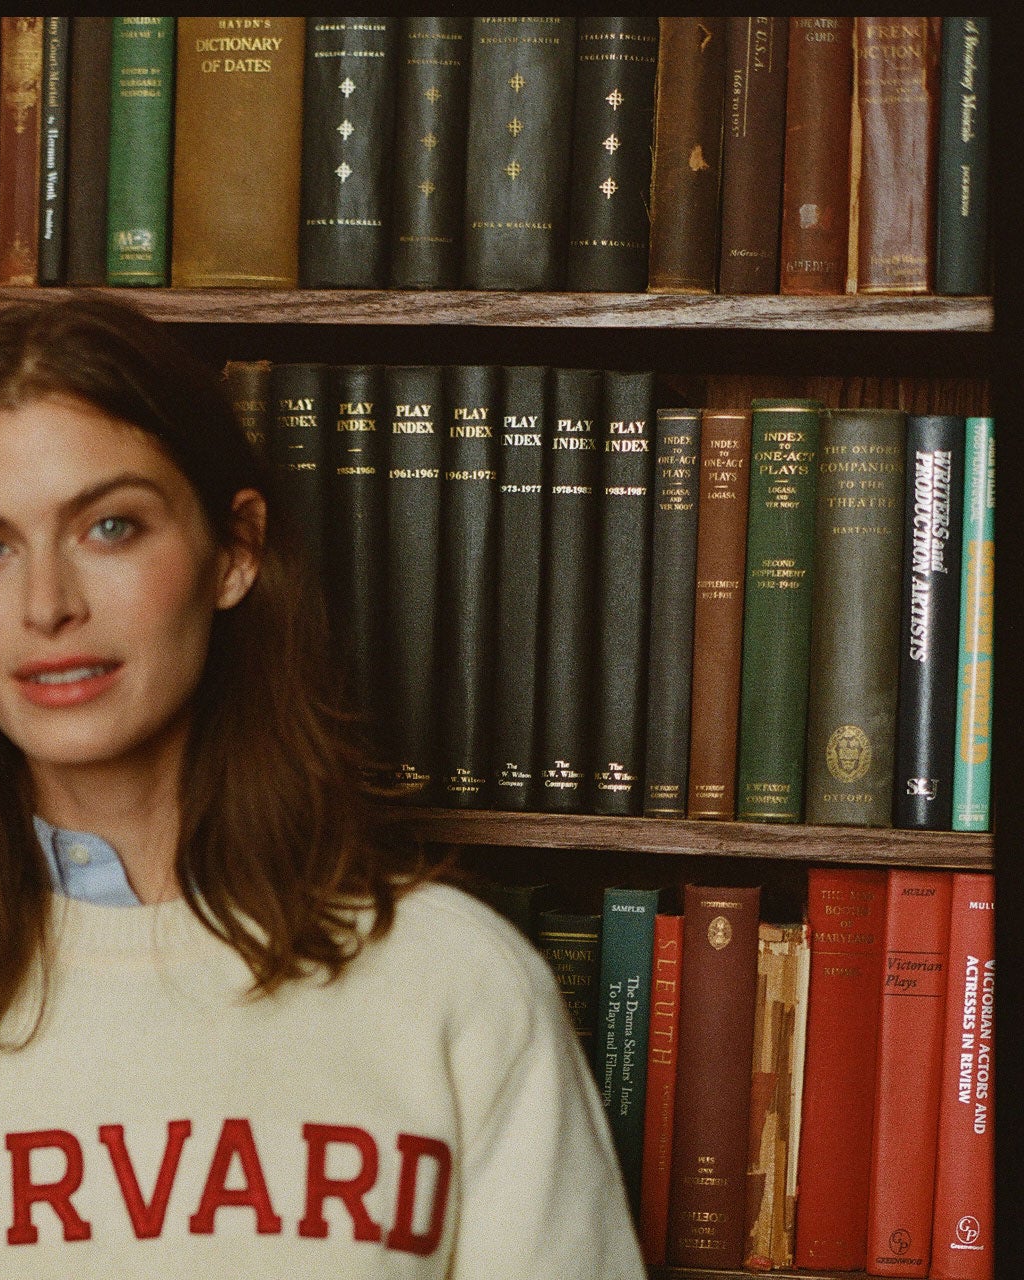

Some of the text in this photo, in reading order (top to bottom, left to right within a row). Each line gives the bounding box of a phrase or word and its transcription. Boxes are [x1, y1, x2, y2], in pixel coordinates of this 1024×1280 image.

[218, 19, 272, 29] HAYDN'S
[196, 37, 282, 52] DICTIONARY
[753, 30, 767, 72] U.S.A.
[202, 59, 272, 73] OF DATES
[733, 68, 743, 95] 1668
[45, 38, 60, 201] Court-Martial Herman Wouk
[339, 402, 374, 415] PLAY
[396, 404, 432, 417] PLAY
[453, 408, 490, 420] PLAY
[336, 419, 377, 432] INDEX
[392, 421, 435, 434] INDEX
[503, 416, 538, 428] PLAY
[557, 419, 593, 432] PLAY
[609, 421, 646, 434] PLAY
[449, 425, 493, 438] INDEX
[763, 432, 806, 443] INDEX
[552, 437, 596, 450] INDEX
[605, 439, 650, 452] INDEX
[663, 436, 693, 446] INDEX
[710, 440, 739, 449] INDEX
[824, 445, 899, 455] THE OXFORD
[658, 455, 696, 465] ONE-ACT
[755, 451, 816, 463] ONE-ACT
[704, 459, 743, 468] ONE-ACT
[819, 463, 903, 473] COMPANION
[389, 468, 440, 479] 1961-1967
[445, 470, 497, 480] 1968-1972
[662, 468, 691, 479] PLAYS
[759, 465, 810, 476] PLAYS
[708, 472, 737, 482] PLAYS
[768, 486, 796, 494] LOGASA
[838, 480, 885, 489] TO THE
[605, 487, 647, 496] 1983-1987
[707, 492, 736, 500] LOGASA
[827, 498, 896, 508] THEATRE
[930, 450, 952, 574] WRITERS and
[908, 451, 933, 663] PRODUCTION ARTISTS
[762, 559, 796, 568] SECOND
[752, 569, 806, 578] SUPPLEMENT
[960, 539, 996, 765] SCREEN WORLD
[555, 760, 570, 768] The
[609, 763, 624, 771] The
[544, 780, 578, 789] Company
[598, 783, 632, 792] Company
[902, 887, 936, 897] MULLIN
[611, 904, 646, 914] SAMPLES
[814, 932, 875, 944] MARYLAND
[887, 957, 943, 973] Victorian
[885, 974, 918, 991] Plays
[609, 981, 621, 998] To
[652, 938, 677, 1066] SLEUTH
[606, 1001, 621, 1029] Plays
[958, 955, 979, 1105] ACTRESSES IN REVIEW
[607, 1032, 619, 1050] and
[619, 975, 639, 1116] The Drama Scholars' Index
[973, 959, 997, 1135] VICTORIAN ACTORS AND
